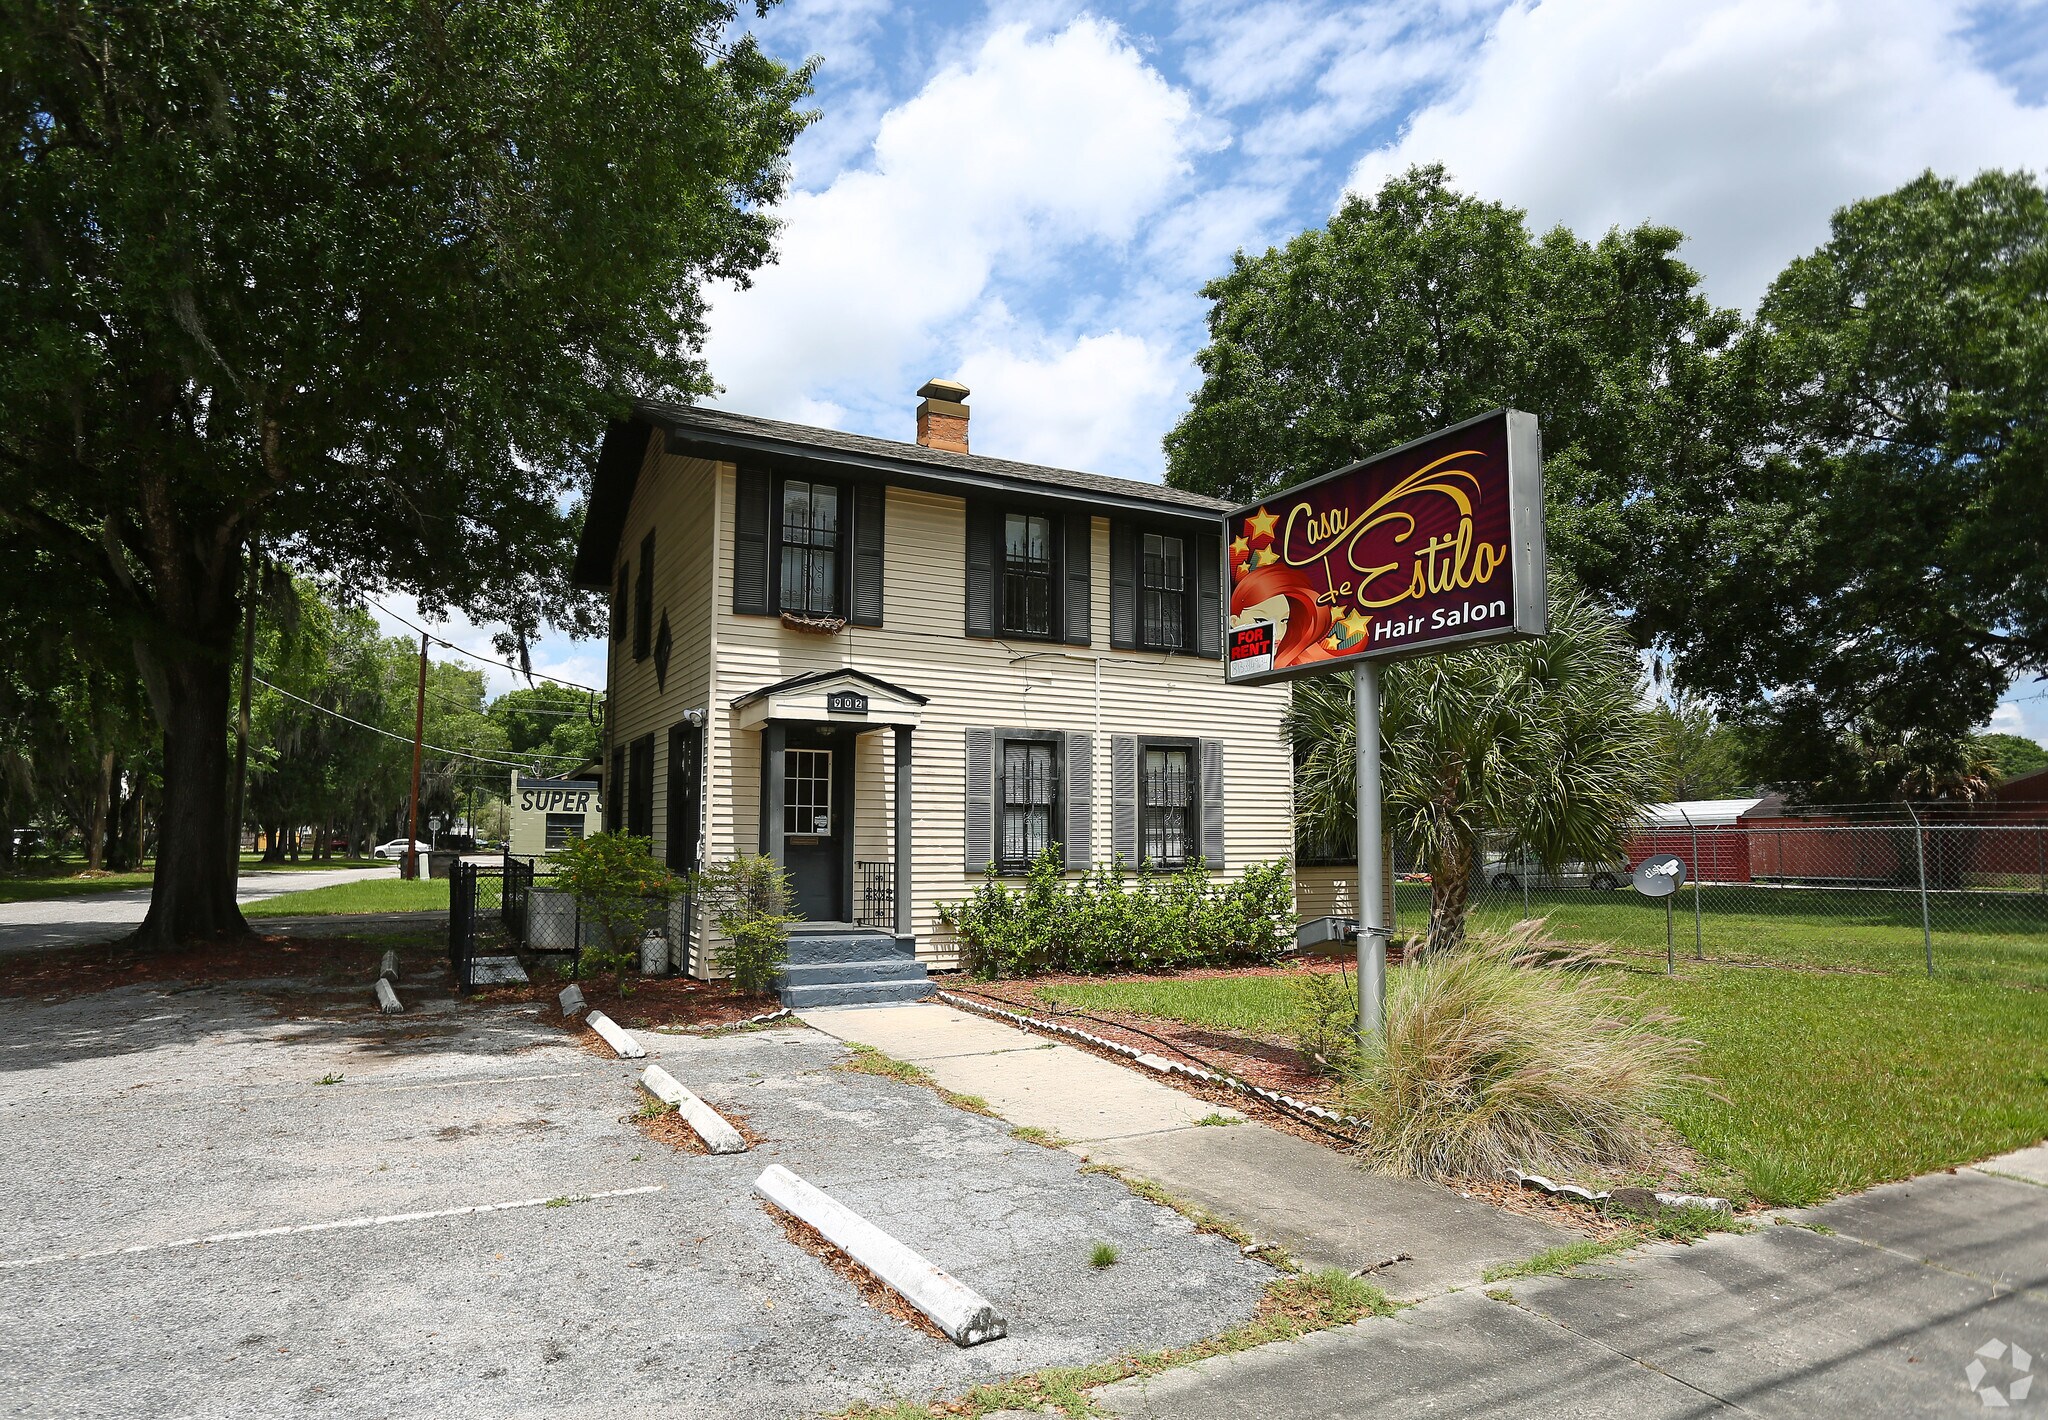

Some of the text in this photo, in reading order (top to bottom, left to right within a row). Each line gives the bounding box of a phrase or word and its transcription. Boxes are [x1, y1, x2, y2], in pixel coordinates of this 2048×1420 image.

[1284, 502, 1349, 566] Casa
[1317, 511, 1507, 608] de Estilo
[1374, 600, 1506, 641] Hair Salon
[1237, 628, 1263, 645] FOR
[1231, 640, 1271, 661] RENT
[834, 698, 862, 708] 902
[521, 790, 590, 812] SUPER
